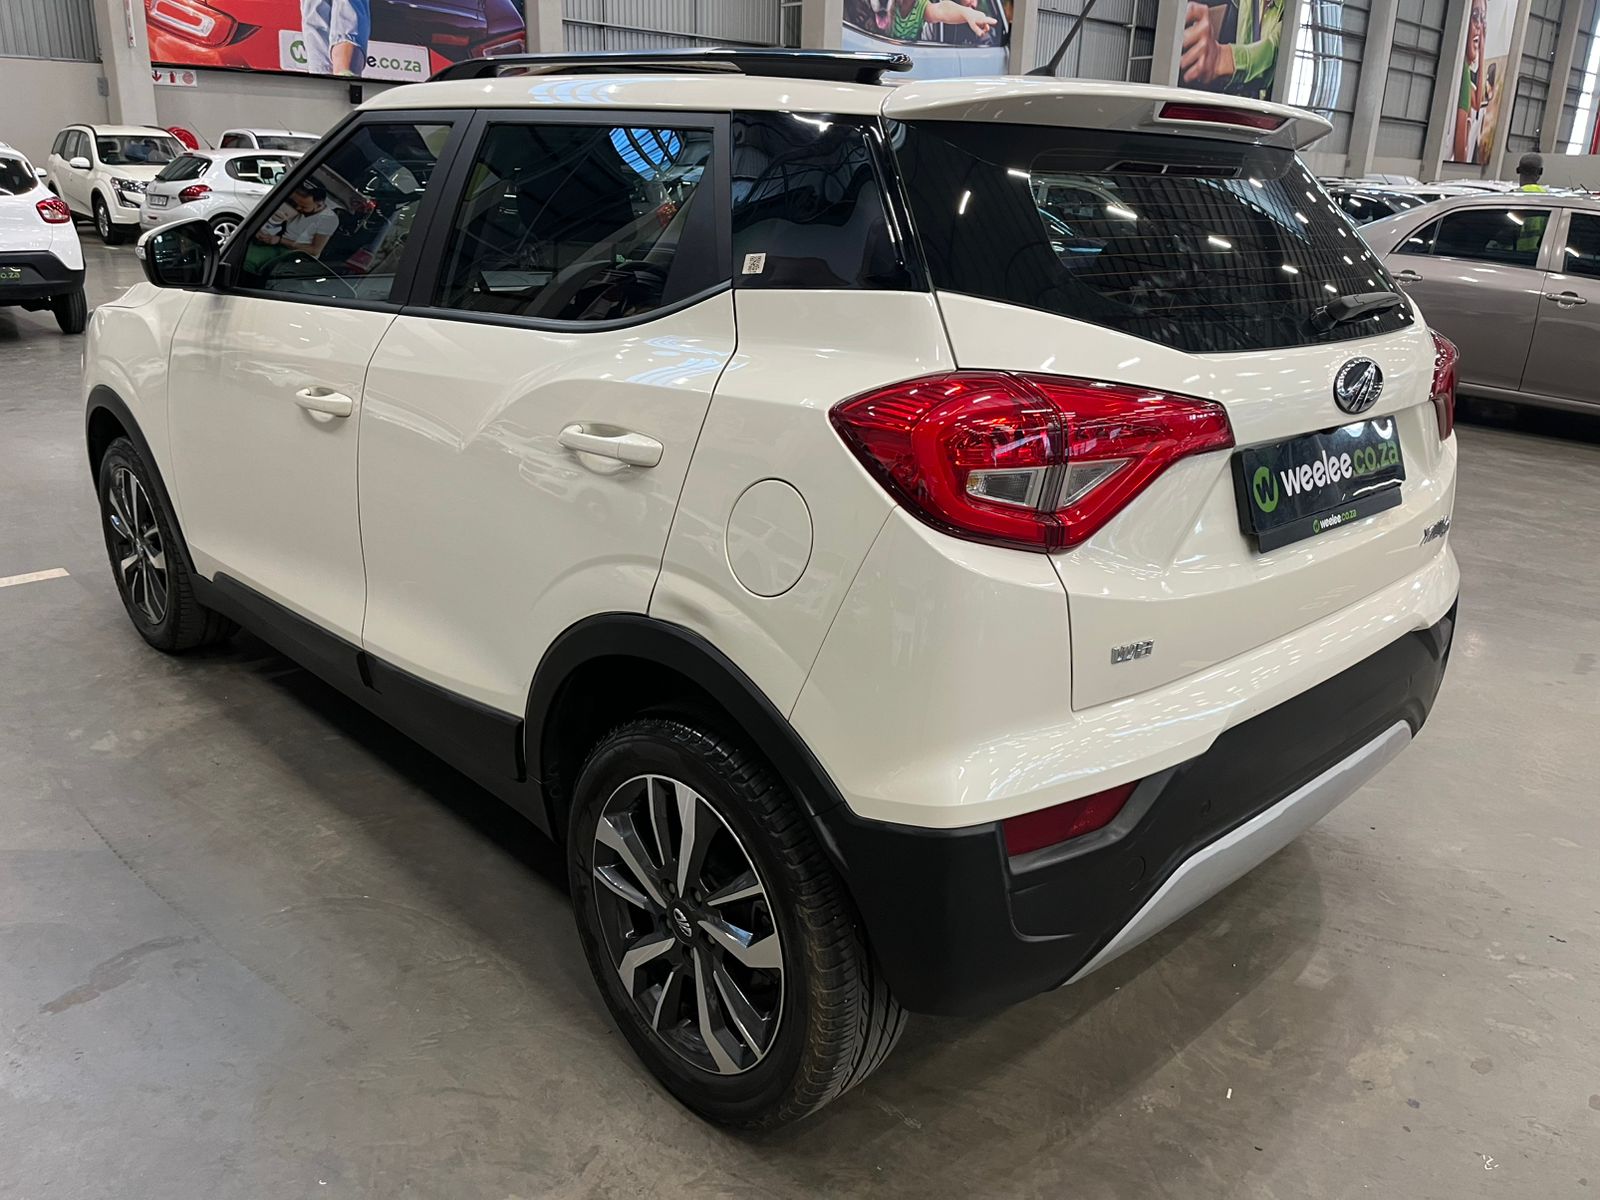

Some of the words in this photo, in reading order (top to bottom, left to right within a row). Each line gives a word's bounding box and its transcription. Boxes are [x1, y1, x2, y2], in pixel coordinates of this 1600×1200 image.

[366, 55, 421, 72] e.co.za
[1280, 440, 1399, 496] weelee.co.za
[1320, 509, 1357, 529] weelee.co.za
